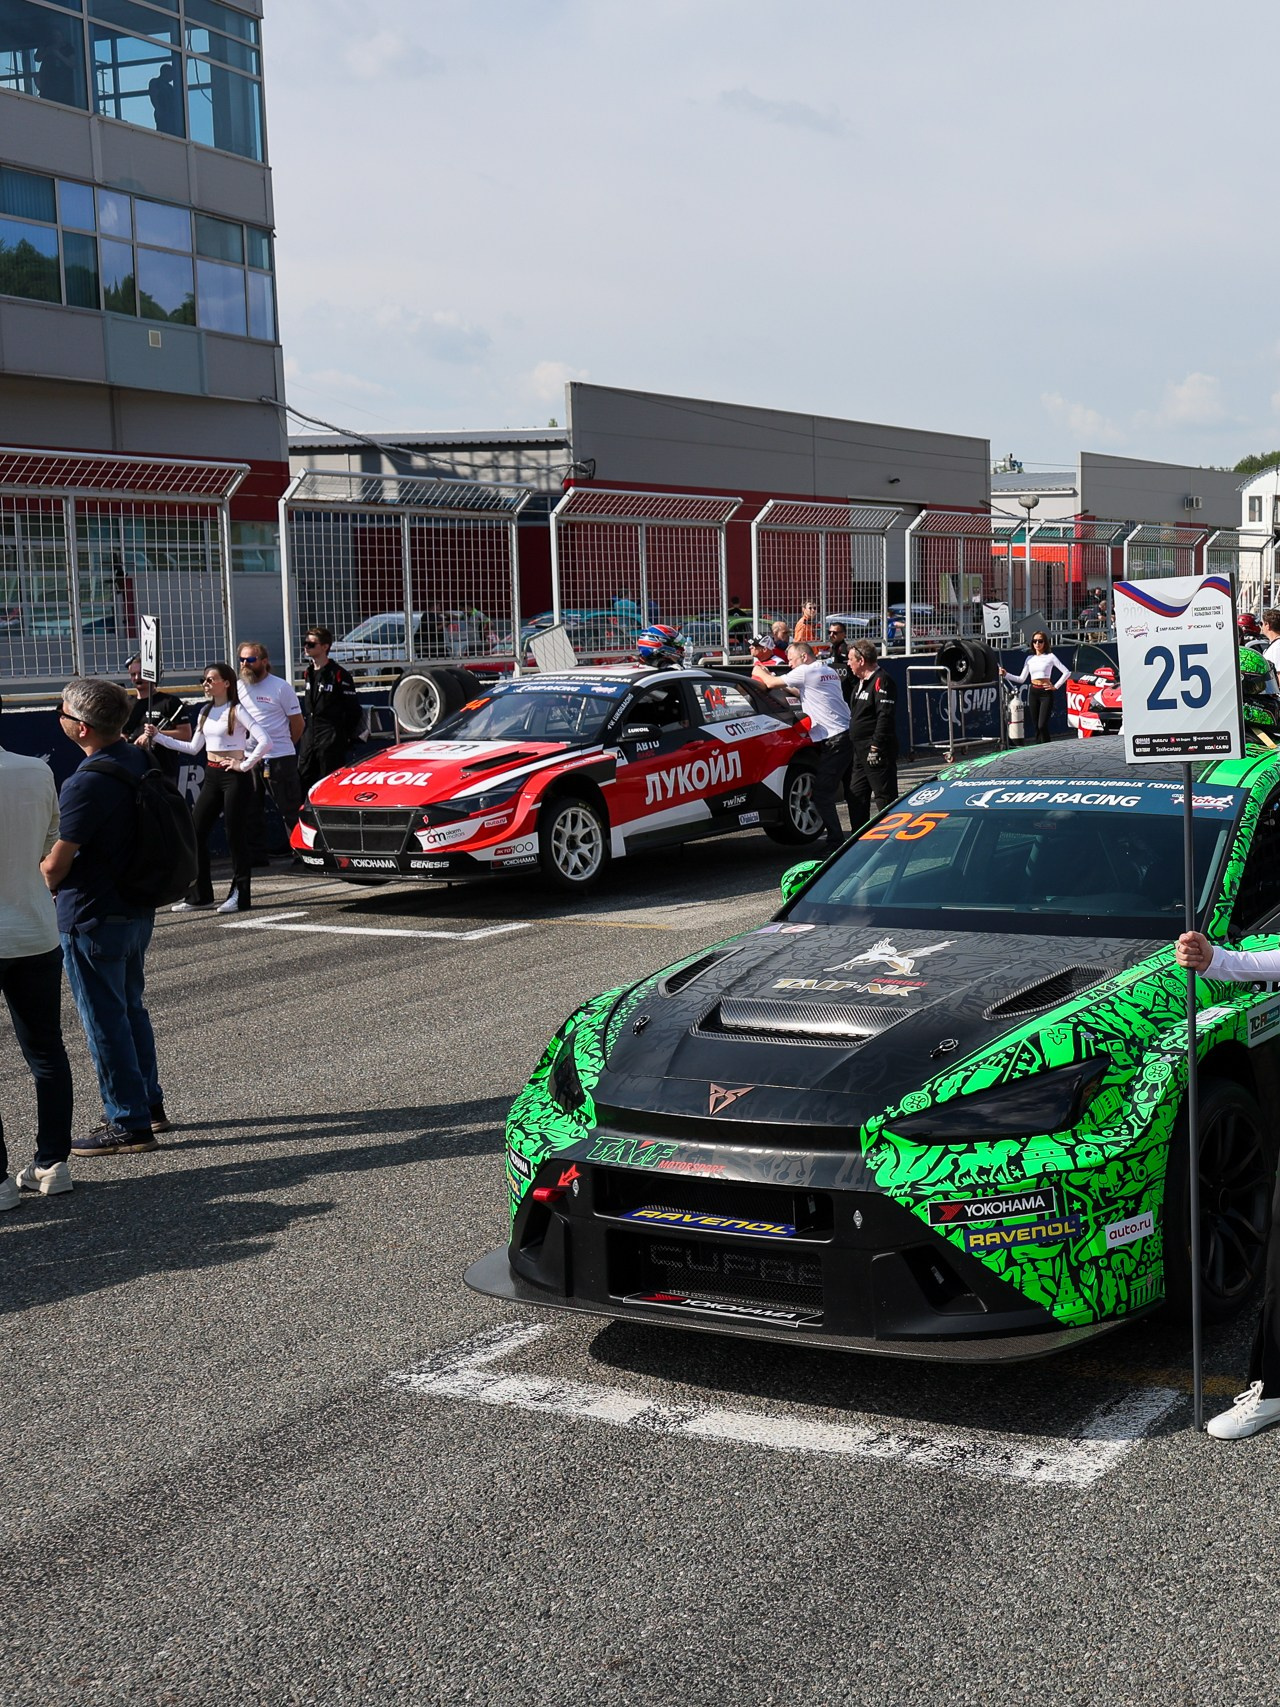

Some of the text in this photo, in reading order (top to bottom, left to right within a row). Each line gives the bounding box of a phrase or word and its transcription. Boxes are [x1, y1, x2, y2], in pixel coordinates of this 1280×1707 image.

[992, 615, 1001, 629] 3
[144, 639, 154, 662] 14
[1143, 643, 1212, 711] 25
[703, 686, 728, 710] 14
[963, 687, 997, 713] SMP
[338, 771, 434, 787] LUKOIL
[645, 748, 742, 805] ЛУКОЙЛ
[950, 779, 1022, 788] Российская
[1025, 779, 1064, 787] серия
[1068, 780, 1144, 788] кольцевых
[995, 792, 1142, 807] SMP RACING
[858, 812, 950, 841] 25
[511, 841, 534, 854] 100
[350, 858, 397, 869] YOKOHAMA
[410, 860, 450, 869] GENESIS
[502, 856, 536, 866] YOKOHAMA
[870, 978, 914, 986] POWERED
[586, 1135, 679, 1168] TAIF
[658, 1159, 726, 1174] MOTORSPORT
[963, 1195, 1046, 1218] YOKOHAMA
[631, 1209, 795, 1236] RAVENOL
[1109, 1217, 1151, 1241] auto.ru
[969, 1221, 1077, 1248] RAVENOL
[681, 1298, 798, 1320] YOKOHAMA
